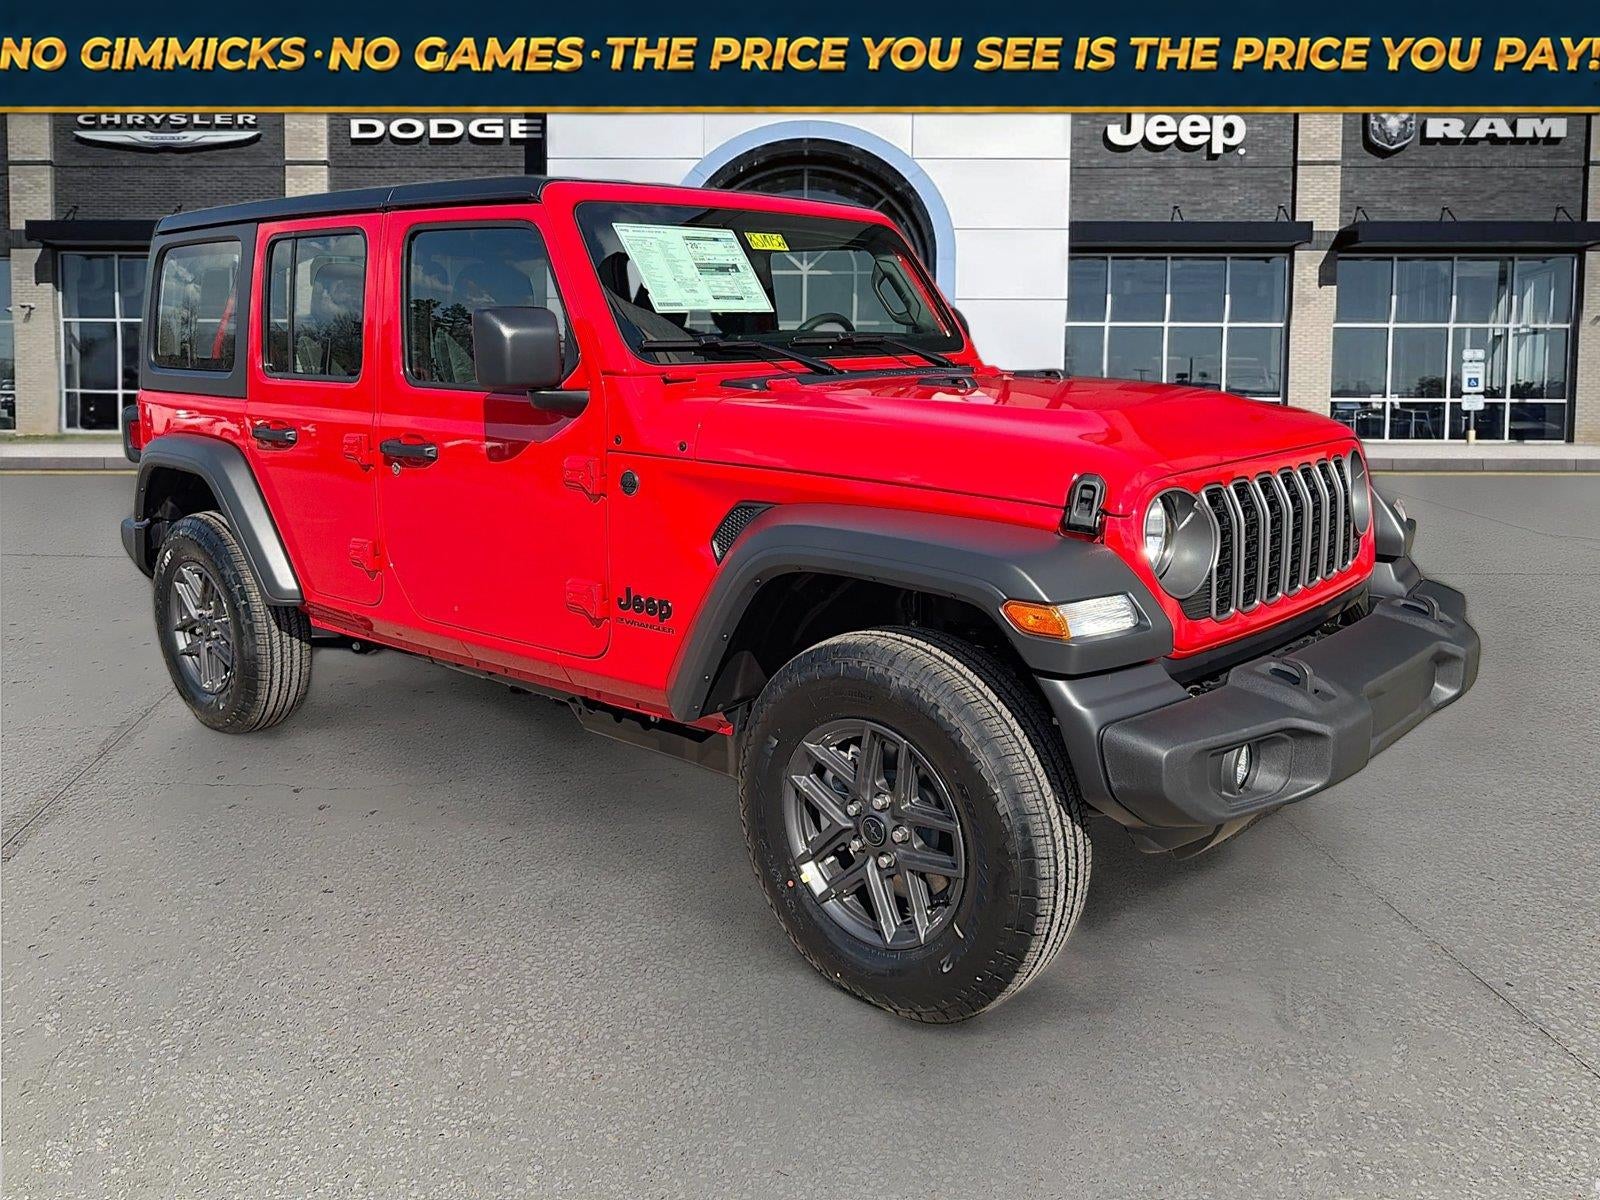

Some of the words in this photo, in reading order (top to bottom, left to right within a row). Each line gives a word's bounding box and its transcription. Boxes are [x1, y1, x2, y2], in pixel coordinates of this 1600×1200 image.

[76, 113, 257, 125] CHRYSLER
[350, 118, 543, 139] DODGE
[1425, 117, 1568, 139] RAM
[1106, 112, 1248, 155] Jeep
[617, 586, 673, 623] Jeep
[624, 618, 675, 635] WRANGLER
